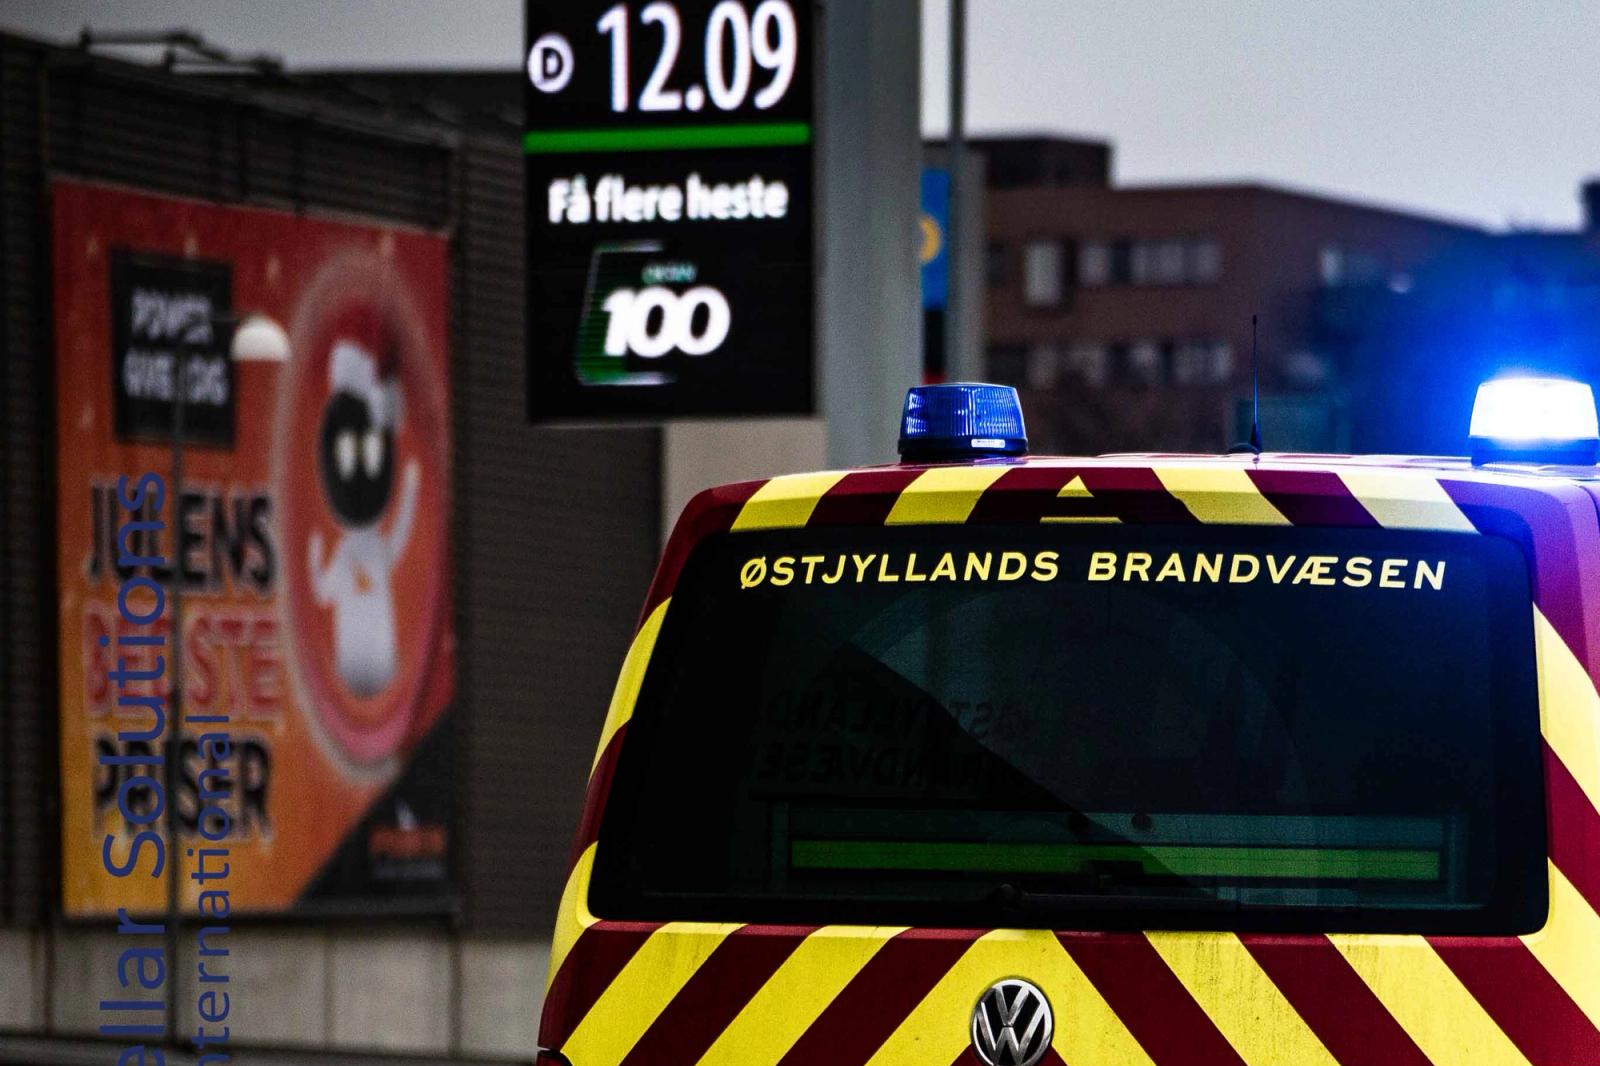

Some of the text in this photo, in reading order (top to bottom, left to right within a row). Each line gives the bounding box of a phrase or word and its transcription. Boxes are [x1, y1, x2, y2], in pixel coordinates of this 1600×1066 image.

[598, 0, 796, 112] 12.09
[548, 174, 788, 223] Få flere heste
[602, 286, 731, 357] 100
[87, 483, 275, 591] JULENS
[740, 551, 1446, 591] ØSTJYLLANDS BRANDVÆSEN
[93, 736, 271, 836] PRSER
